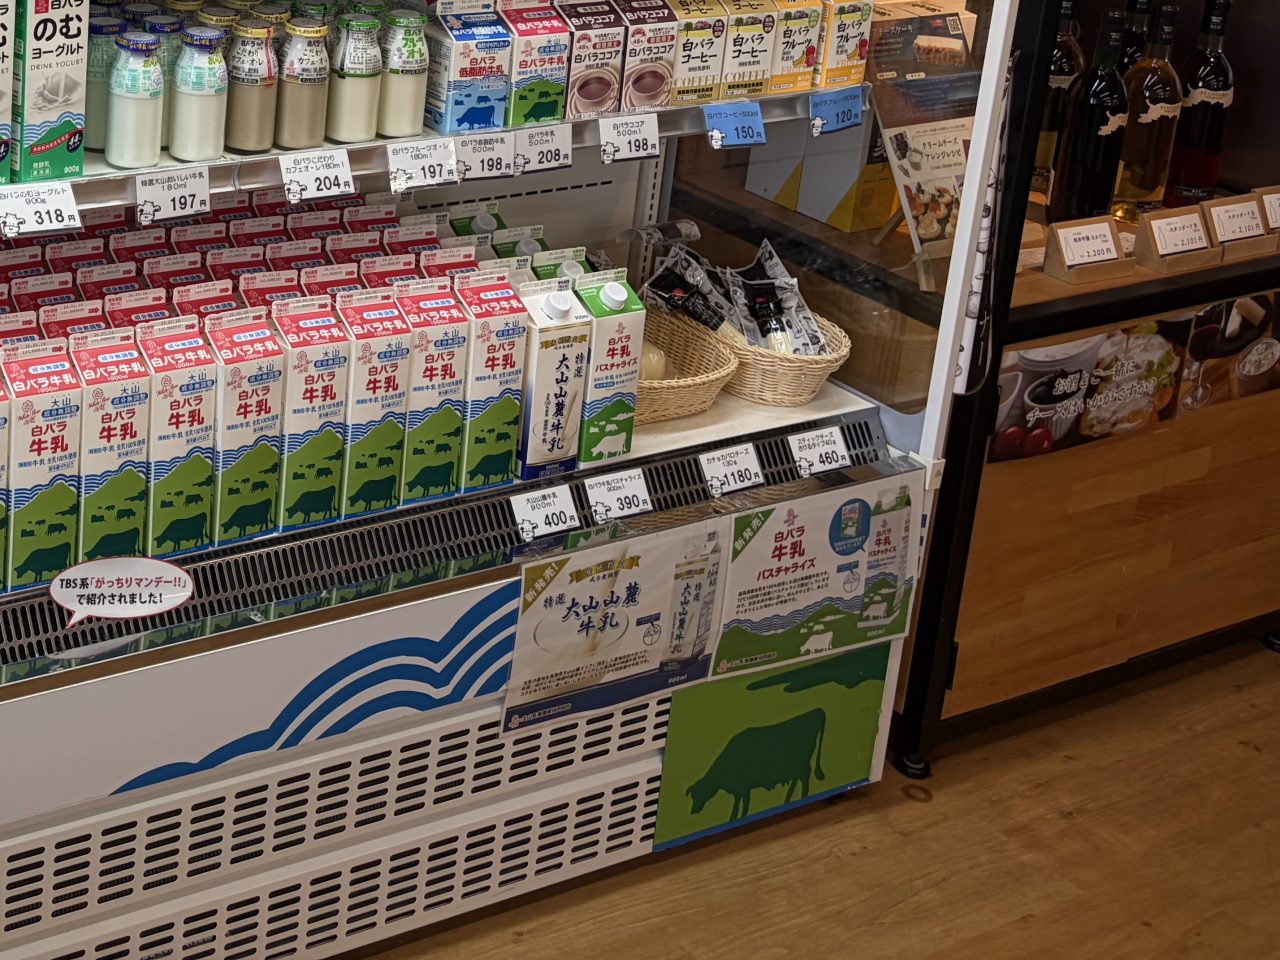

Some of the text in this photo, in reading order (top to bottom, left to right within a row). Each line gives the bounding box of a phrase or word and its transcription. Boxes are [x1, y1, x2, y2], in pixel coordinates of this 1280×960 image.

[33, 14, 83, 42] のむ
[574, 51, 620, 64] 白バラココア
[681, 52, 718, 63] コーヒー
[612, 120, 645, 130] 白バラココア
[528, 131, 555, 140] 白バラ牛乳
[293, 155, 335, 166] 白バラこだわり
[141, 172, 205, 188] 特選大山おいしい牛乳
[606, 345, 631, 359] 牛乳
[484, 352, 516, 371] 牛乳
[99, 422, 137, 443] 牛乳
[774, 526, 805, 542] 白バラ
[771, 540, 805, 562] 牛乳
[578, 612, 619, 637] 牛乳
